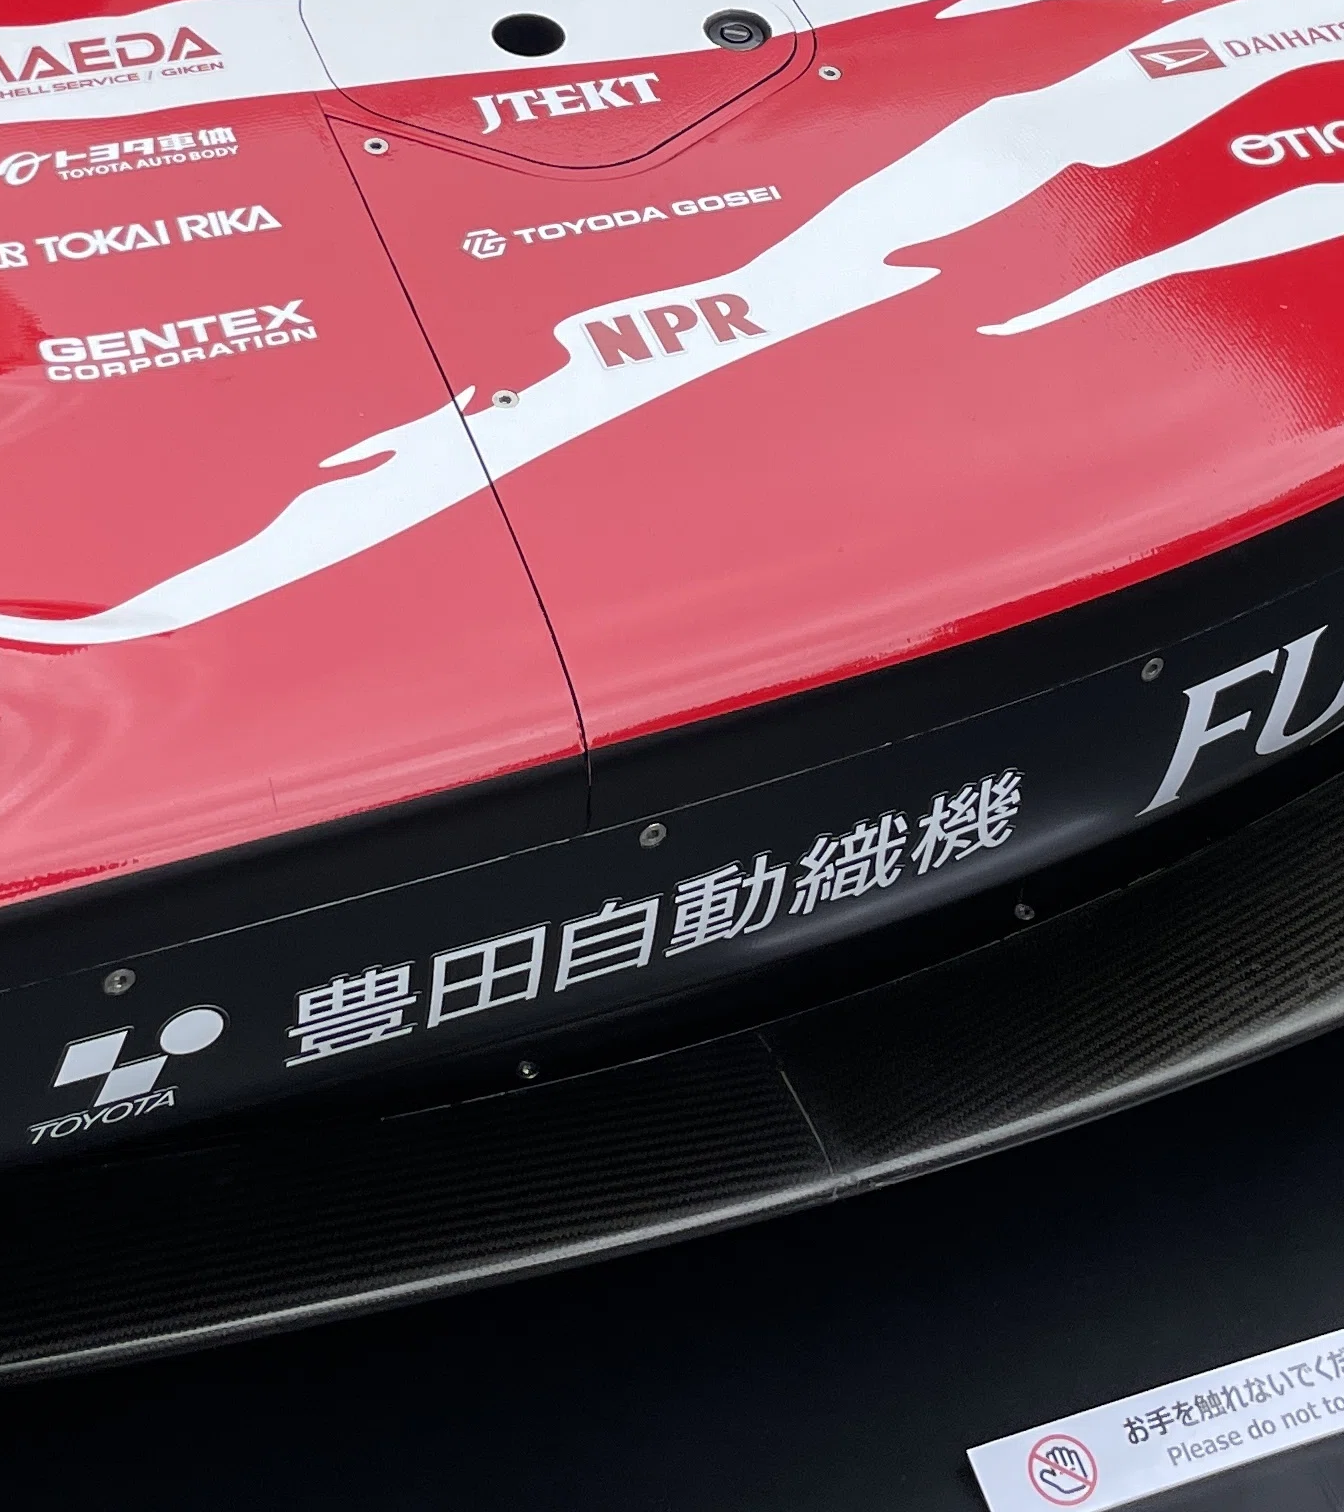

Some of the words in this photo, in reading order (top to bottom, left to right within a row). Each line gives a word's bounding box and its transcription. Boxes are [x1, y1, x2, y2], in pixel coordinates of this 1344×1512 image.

[52, 72, 140, 91] SERVICE
[160, 61, 225, 77] GIKEN
[472, 73, 660, 135] JTEKT
[56, 126, 238, 169] トヨタ車体
[57, 160, 133, 181] TOYOTA
[137, 152, 187, 170] AUTO
[190, 145, 239, 162] BODY
[35, 219, 172, 263] TOKAI
[177, 205, 282, 242] RIKA
[513, 207, 668, 246] TOYODA
[671, 185, 782, 218] GOSEI
[38, 299, 311, 363] GENTEX
[47, 325, 318, 382] CORPORATION
[584, 293, 767, 368] NPR
[285, 769, 1025, 1068] 豊田自動織機
[26, 1089, 177, 1146] TOYOTA
[1167, 1431, 1244, 1467] Please
[1248, 1416, 1277, 1440] do
[1283, 1404, 1320, 1430] not
